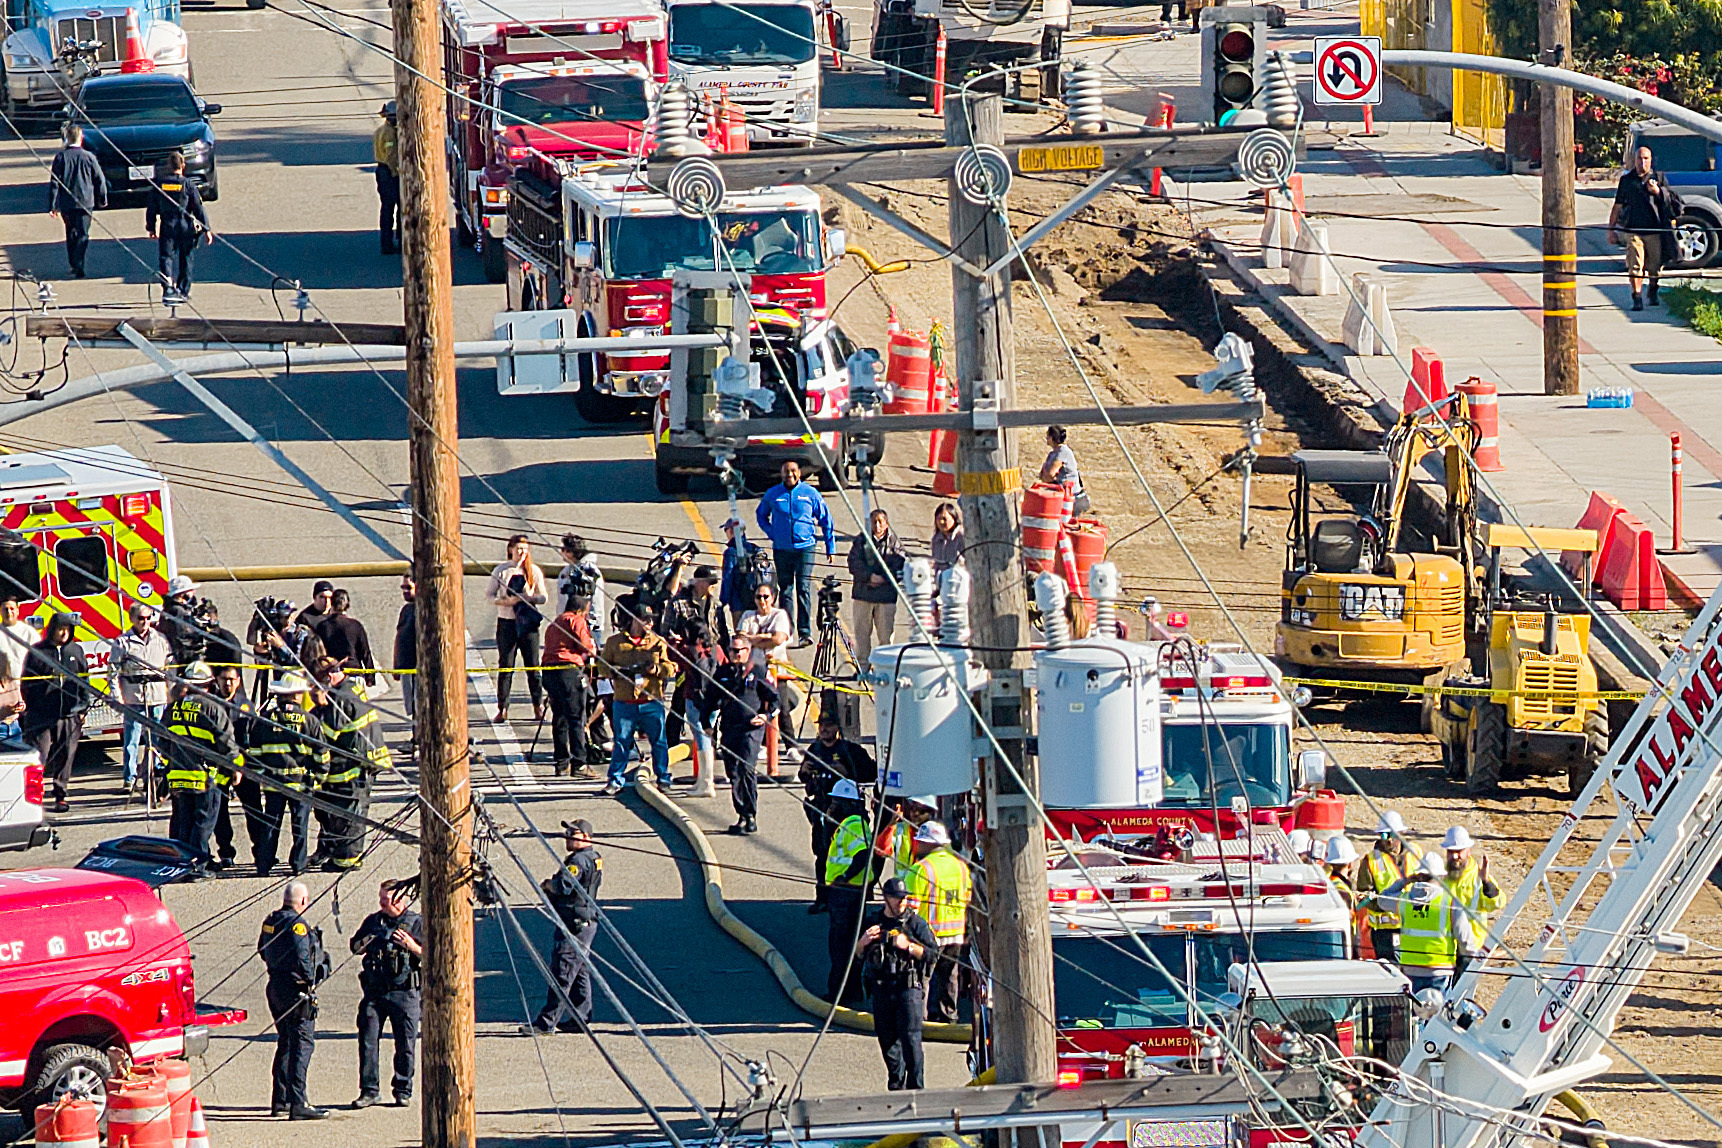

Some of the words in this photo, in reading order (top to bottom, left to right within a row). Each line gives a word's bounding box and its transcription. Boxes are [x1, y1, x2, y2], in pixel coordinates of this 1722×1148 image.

[1022, 148, 1046, 169] HIGH
[1053, 146, 1100, 167] VOLTAGE
[1344, 585, 1400, 620] CAT
[1110, 817, 1154, 826] ALAMEDA
[1156, 816, 1194, 826] COUNTY
[1561, 818, 1573, 831] 70
[83, 854, 120, 869] BC2
[150, 863, 187, 878] ACF
[85, 926, 129, 951] BC2
